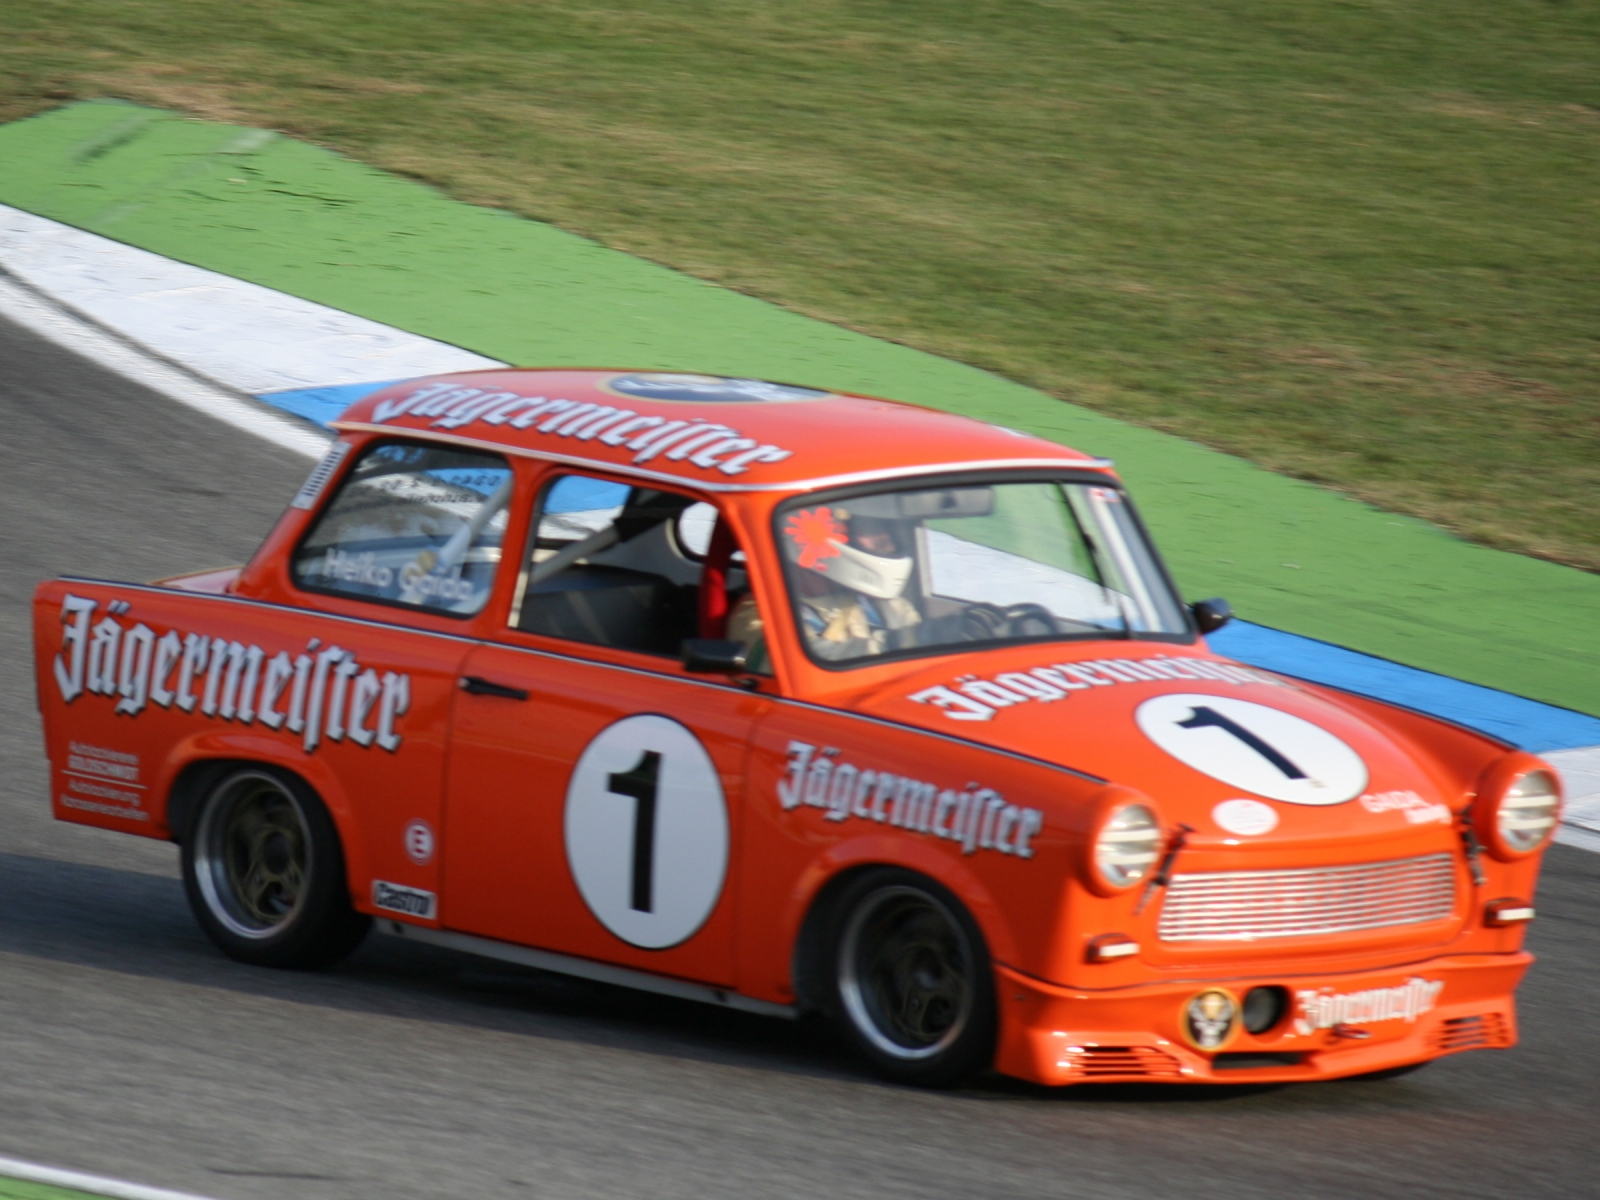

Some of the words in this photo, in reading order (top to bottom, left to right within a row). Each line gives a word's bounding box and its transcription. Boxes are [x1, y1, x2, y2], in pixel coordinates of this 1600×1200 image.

[324, 548, 393, 588] Heiko
[54, 594, 410, 752] Jägermeister
[1173, 706, 1310, 779] 1
[606, 750, 662, 914] 1
